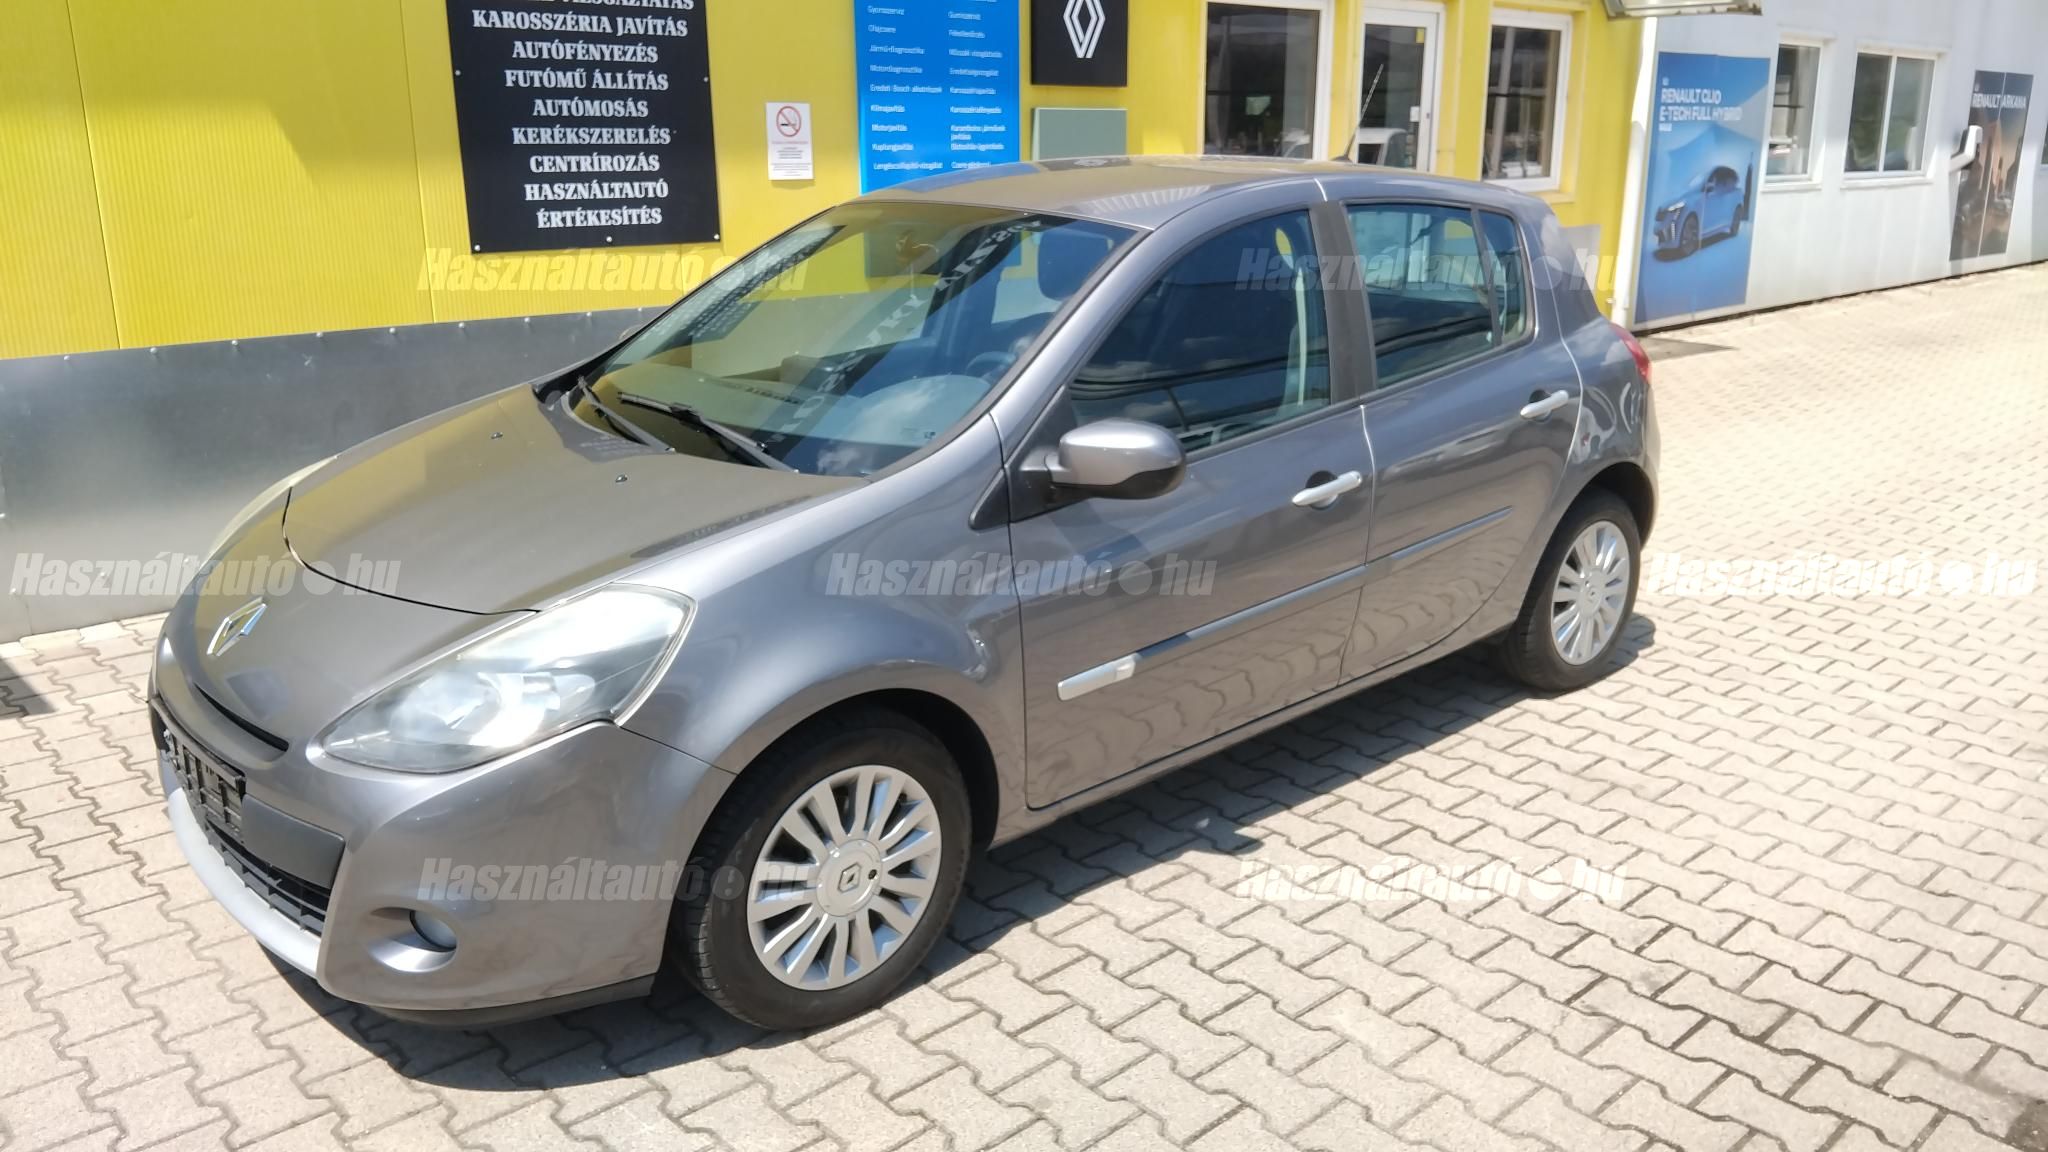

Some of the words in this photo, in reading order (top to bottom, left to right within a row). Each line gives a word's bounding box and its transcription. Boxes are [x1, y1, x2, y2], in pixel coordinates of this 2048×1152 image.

[472, 10, 613, 33] KAROSSZÉRIA
[615, 15, 688, 37] JAVÍTÁS
[512, 39, 659, 63] AUTÓFÉNYEZÉS
[504, 67, 587, 89] FUTÓMŰ
[591, 69, 669, 91] ÁLLÍTÁS
[1661, 87, 1700, 104] RENAULT
[1701, 88, 1722, 105] CLIO
[1972, 92, 2001, 109] RENAULT
[532, 98, 649, 118] AUTÓMOSÁS
[1659, 105, 1692, 122] E-TECH
[1692, 105, 1712, 121] FULL
[512, 124, 671, 145] KERÉKSZERELÉS
[529, 152, 660, 173] CENTRÍROZÁS
[524, 178, 669, 201] HASZNÁLTAUTÓ
[536, 206, 663, 229] ÉRTÉKESÍTÉS
